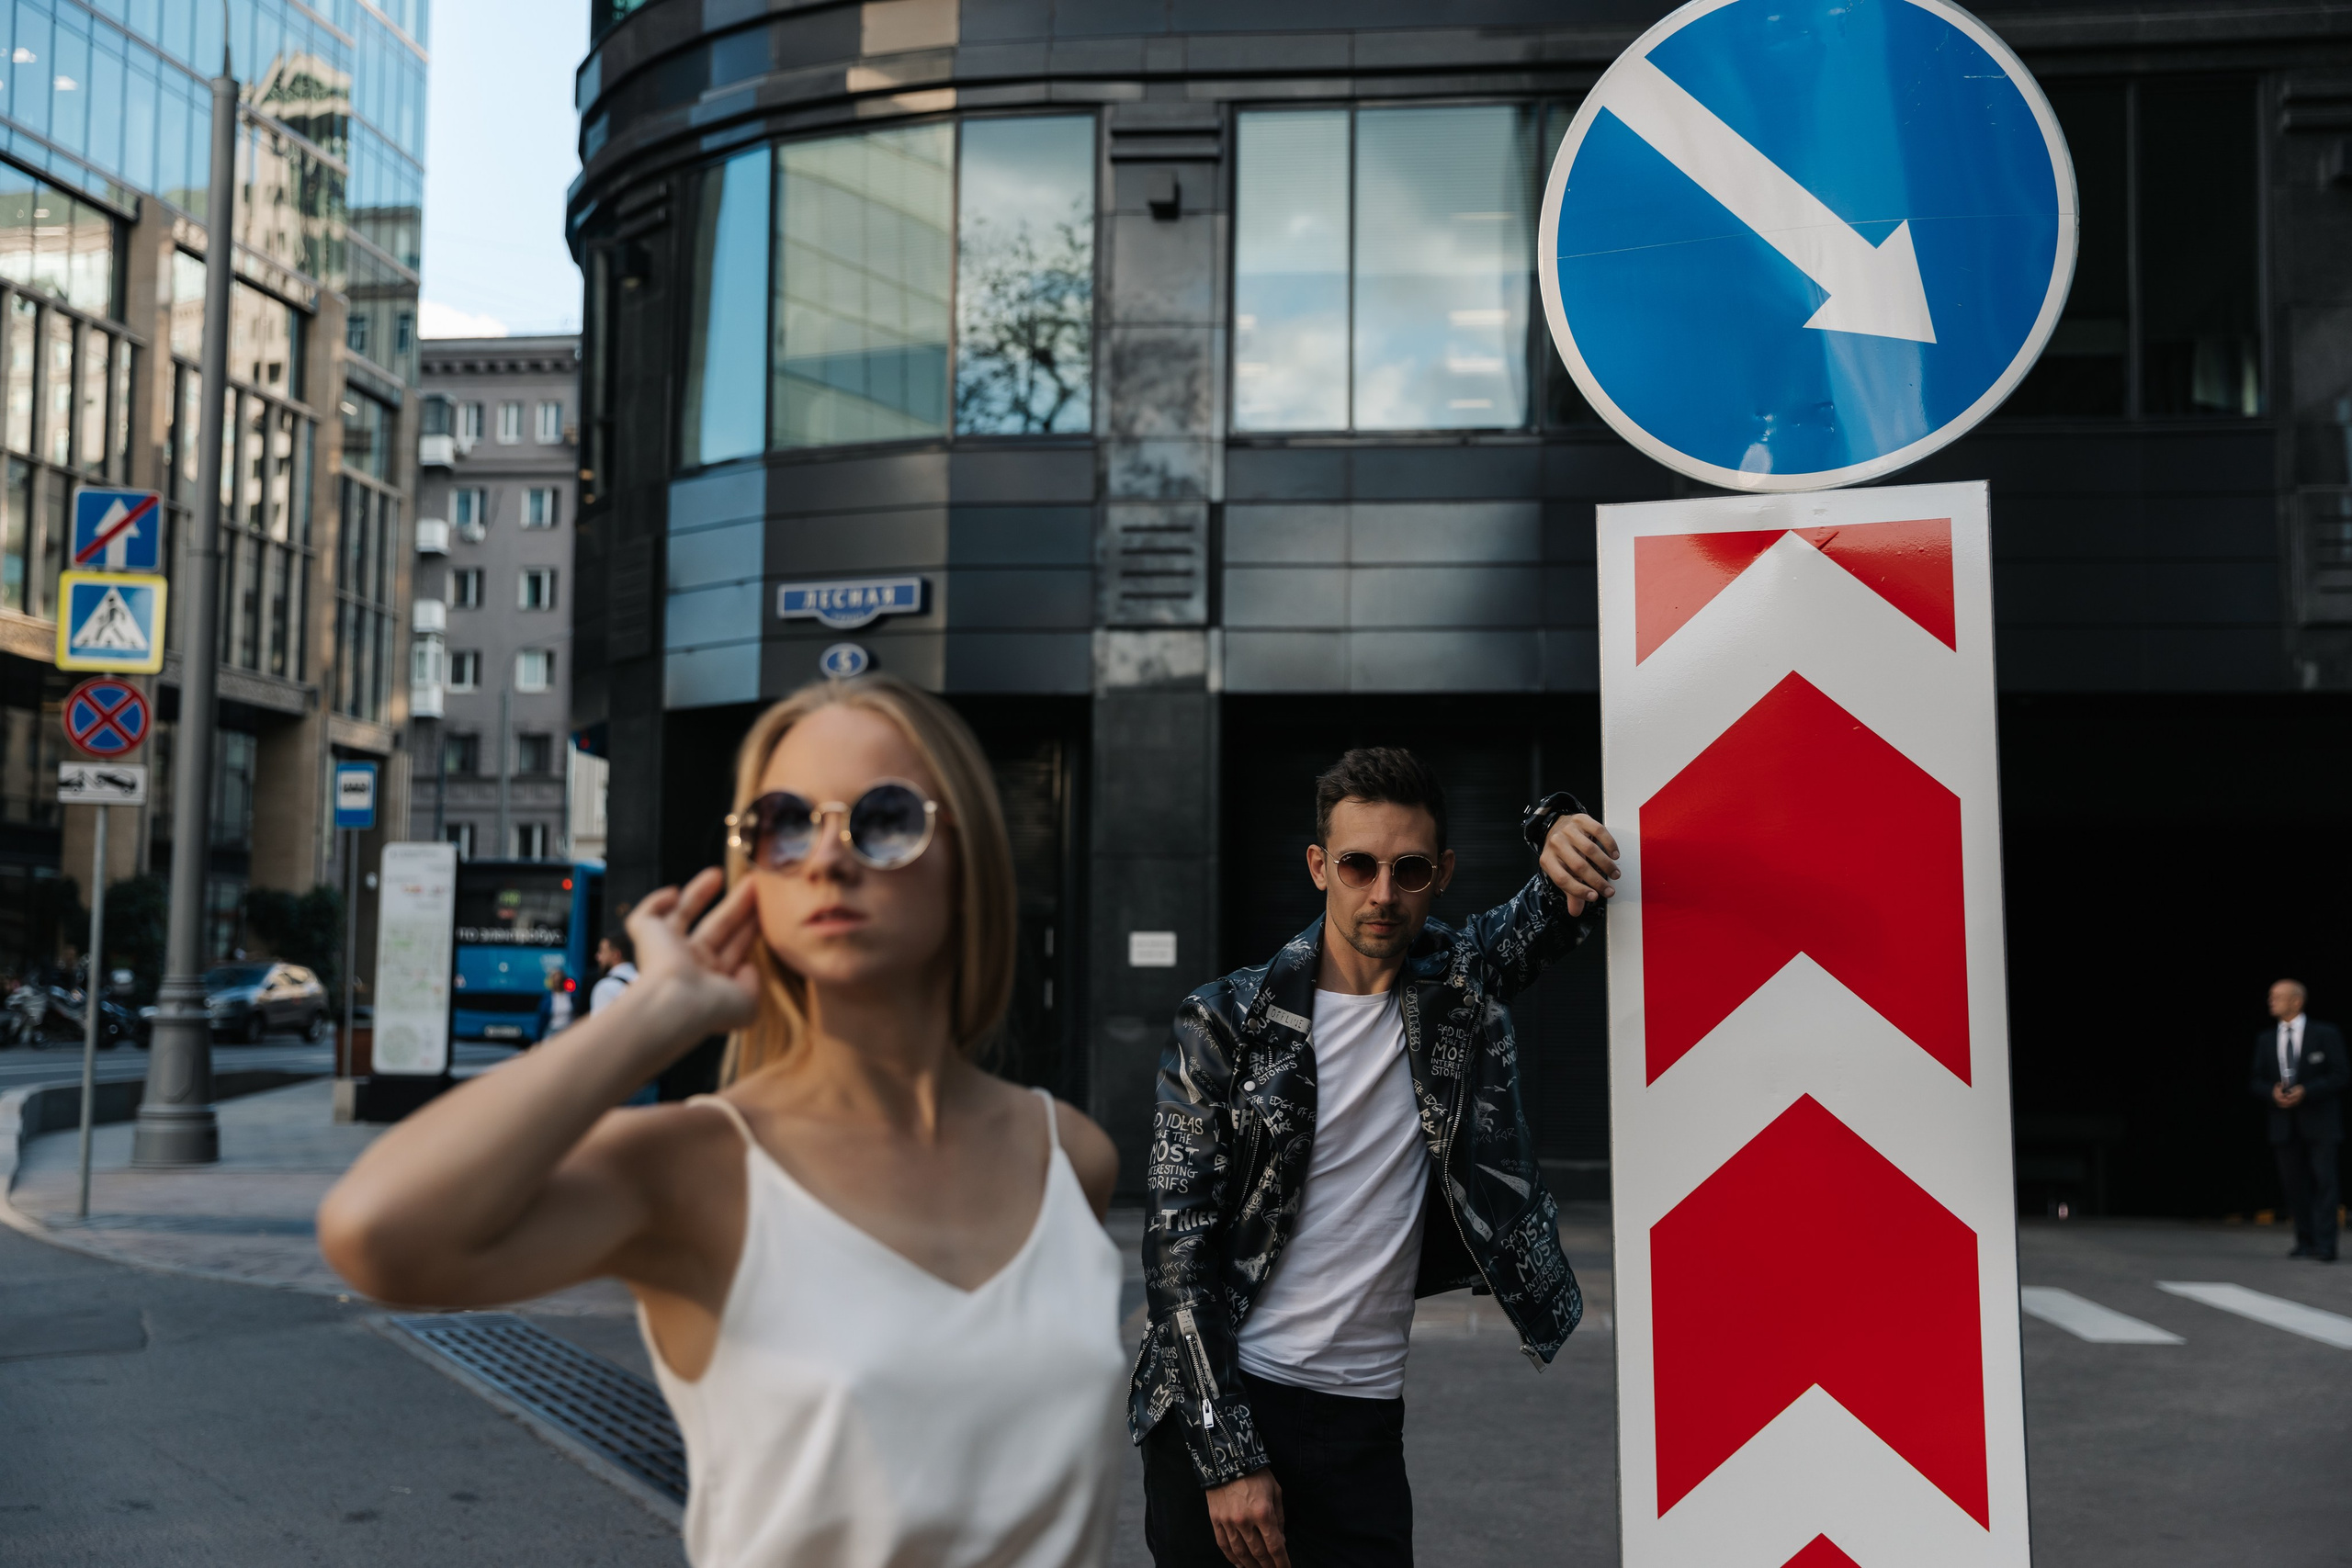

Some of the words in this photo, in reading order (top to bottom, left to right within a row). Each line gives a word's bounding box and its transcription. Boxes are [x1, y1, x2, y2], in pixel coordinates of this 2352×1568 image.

[802, 587, 896, 609] ЛЕСНАЯ
[1269, 1095, 1295, 1111] EDGE
[1423, 1093, 1449, 1118] EDGE
[1166, 1112, 1204, 1136] IDEAS
[1172, 1132, 1193, 1145] THE
[1148, 1140, 1200, 1166] MOST
[1160, 1208, 1219, 1232] THIEF
